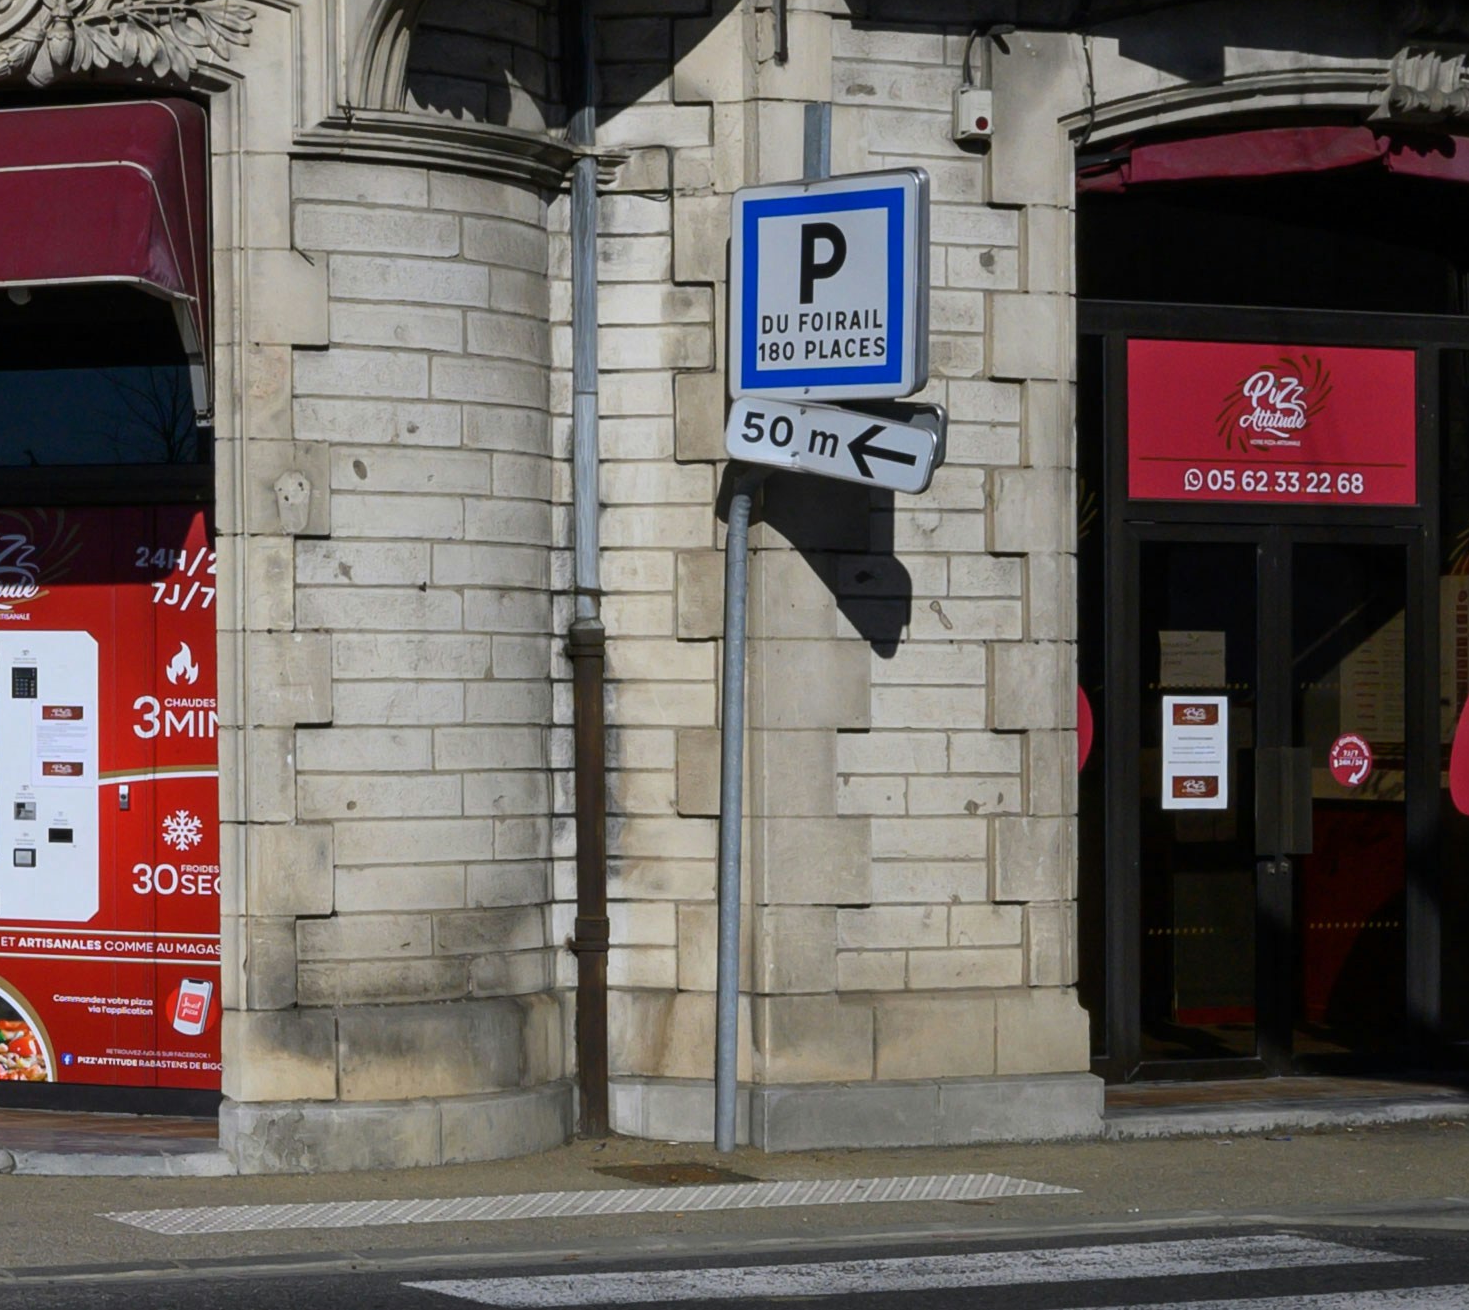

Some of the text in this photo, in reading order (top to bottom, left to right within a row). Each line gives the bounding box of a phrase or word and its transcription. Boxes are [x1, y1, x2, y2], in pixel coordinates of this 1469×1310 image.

[799, 221, 847, 304] P
[761, 309, 884, 336] DU FOIRAIL
[758, 336, 886, 363] 180 PLACES
[1239, 406, 1307, 431] Attitude
[741, 410, 839, 459] 50 m
[1207, 468, 1364, 494] 05.62.33.22.68
[151, 581, 216, 611] 7J/7
[164, 697, 217, 708] CHAUDES
[133, 695, 161, 739] 3
[132, 863, 179, 896] 30
[180, 864, 220, 874] FROIDES
[0, 936, 16, 947] ET
[17, 937, 102, 951] ARTISANALES
[104, 940, 153, 953] COMME
[156, 942, 174, 954] AU
[107, 997, 130, 1005] votre
[130, 997, 154, 1007] pizza
[189, 1061, 201, 1070] DE
